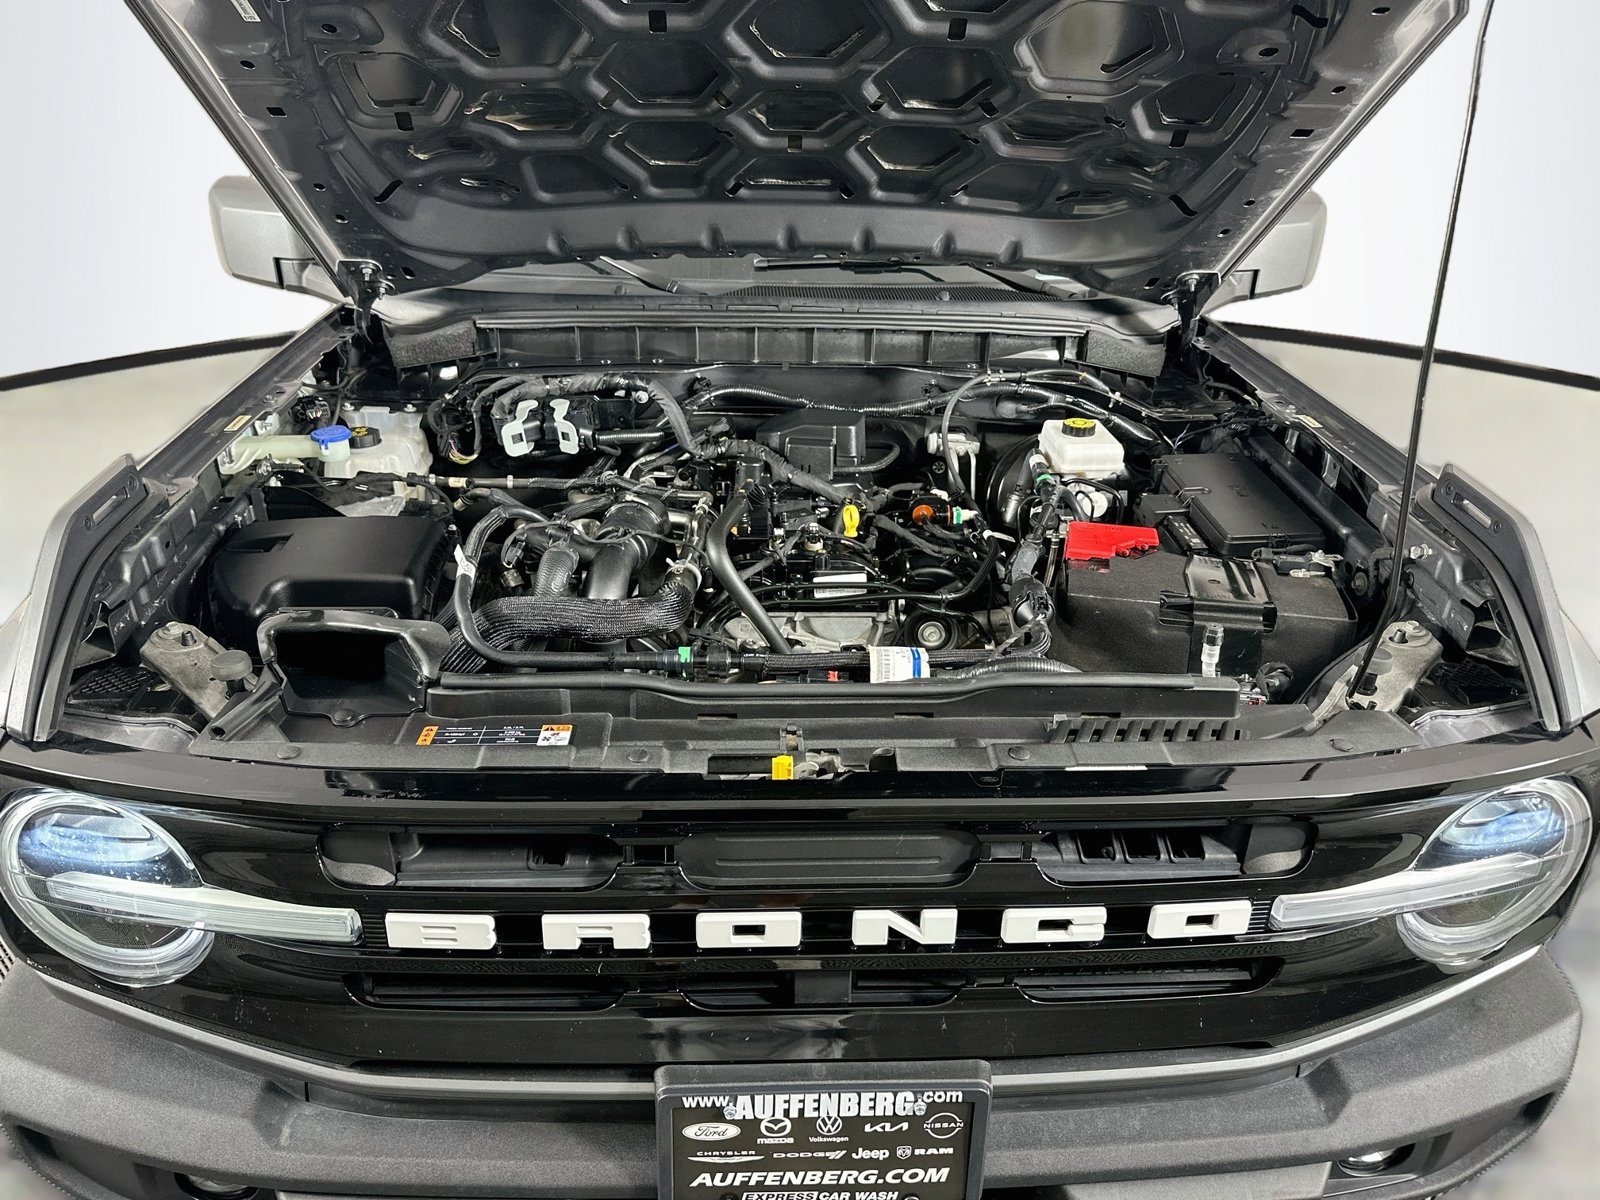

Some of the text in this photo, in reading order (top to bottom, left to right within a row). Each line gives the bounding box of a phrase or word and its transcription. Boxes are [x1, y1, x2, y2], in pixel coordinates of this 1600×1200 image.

[385, 899, 1253, 950] BRONCO
[694, 1126, 728, 1137] Ford
[851, 1147, 890, 1160] Jeep
[914, 1147, 954, 1155] RAM
[689, 1167, 951, 1187] AUFFENBERG.COM
[819, 1191, 851, 1200] CAR
[855, 1191, 899, 1200] WASH
